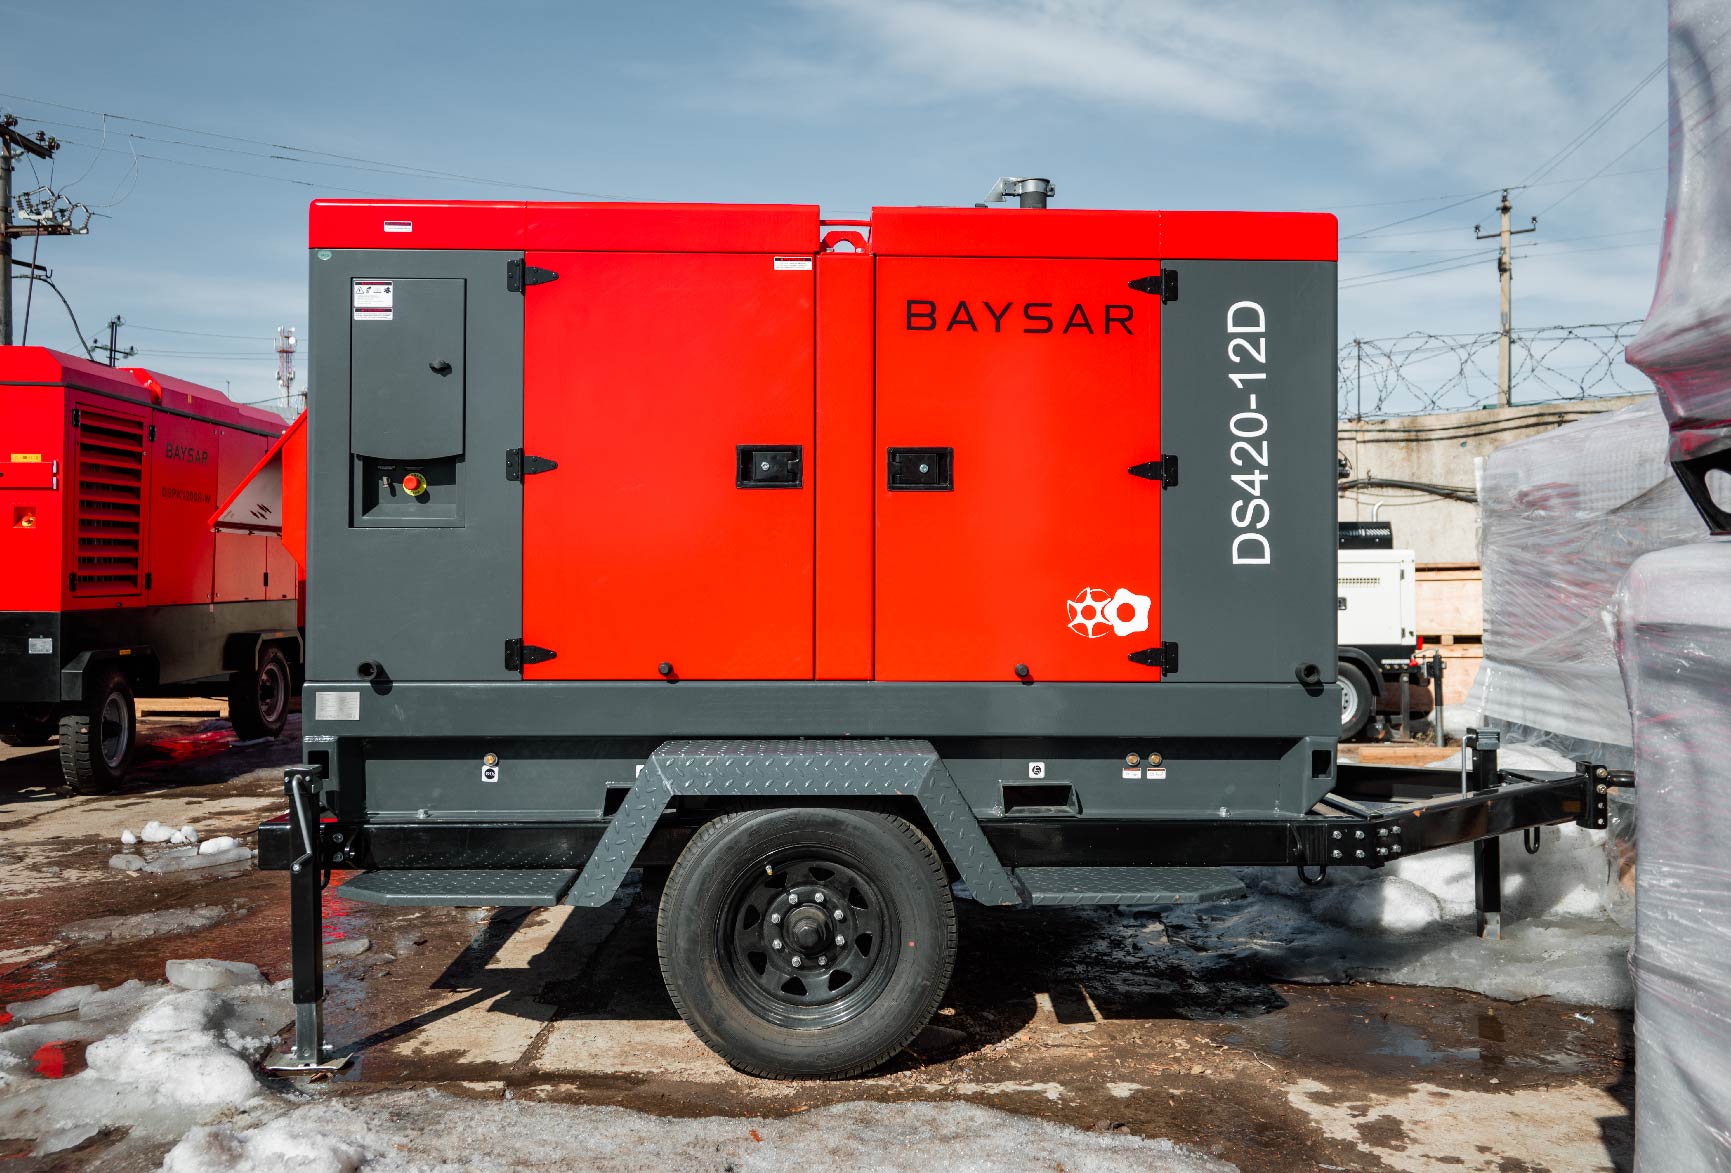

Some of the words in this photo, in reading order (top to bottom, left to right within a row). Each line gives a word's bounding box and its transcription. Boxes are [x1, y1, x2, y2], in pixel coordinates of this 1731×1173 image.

[906, 299, 1134, 335] BAYSAR
[1227, 300, 1271, 565] DS420-12D
[166, 442, 209, 465] BAYSAR
